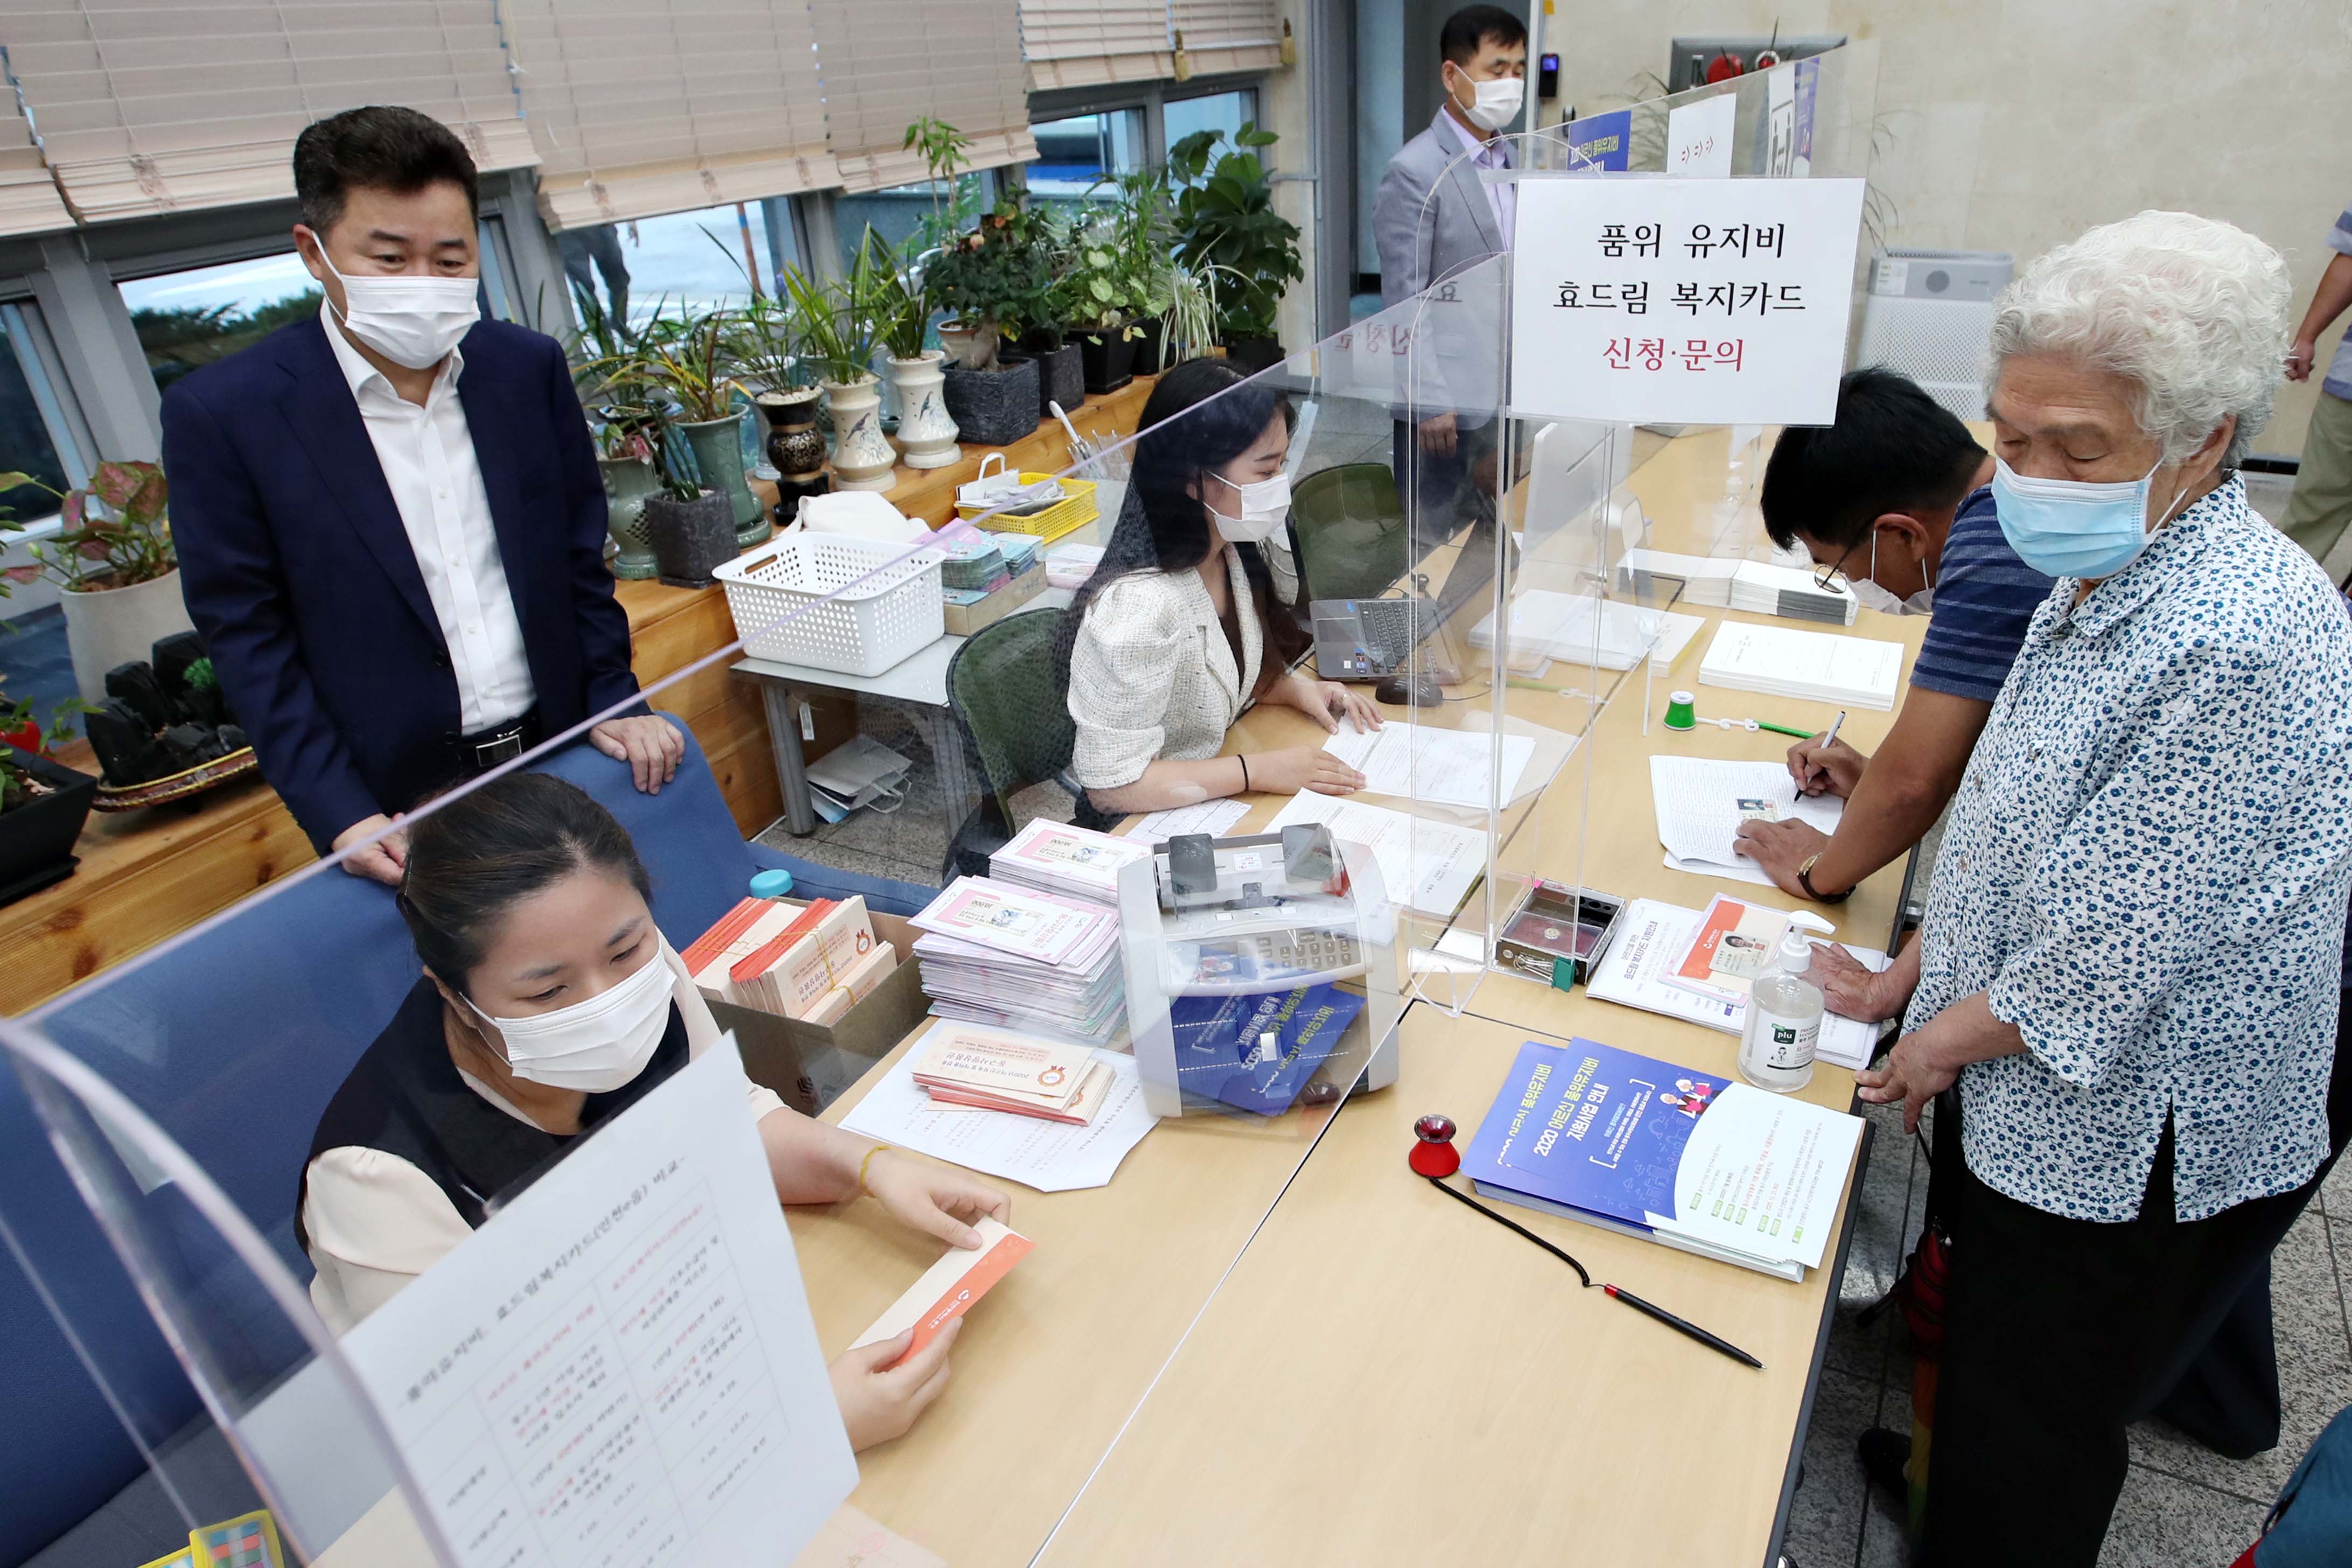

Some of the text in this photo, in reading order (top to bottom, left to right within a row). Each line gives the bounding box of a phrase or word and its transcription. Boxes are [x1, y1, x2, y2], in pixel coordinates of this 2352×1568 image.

[1593, 135, 1619, 156] 품위유지비
[1598, 223, 1784, 258] 품위 유지비
[1553, 282, 1805, 316] 효드림 복지카드
[1604, 338, 1742, 372] 신청·문의
[1624, 963, 1639, 980] 효드림
[1632, 941, 1649, 963] 복지카드
[1521, 1063, 1552, 1109] 품위유지비
[1534, 1056, 1600, 1157] 2020 어르신 품위유지비
[1566, 1082, 1610, 1142] 지원사업 안내
